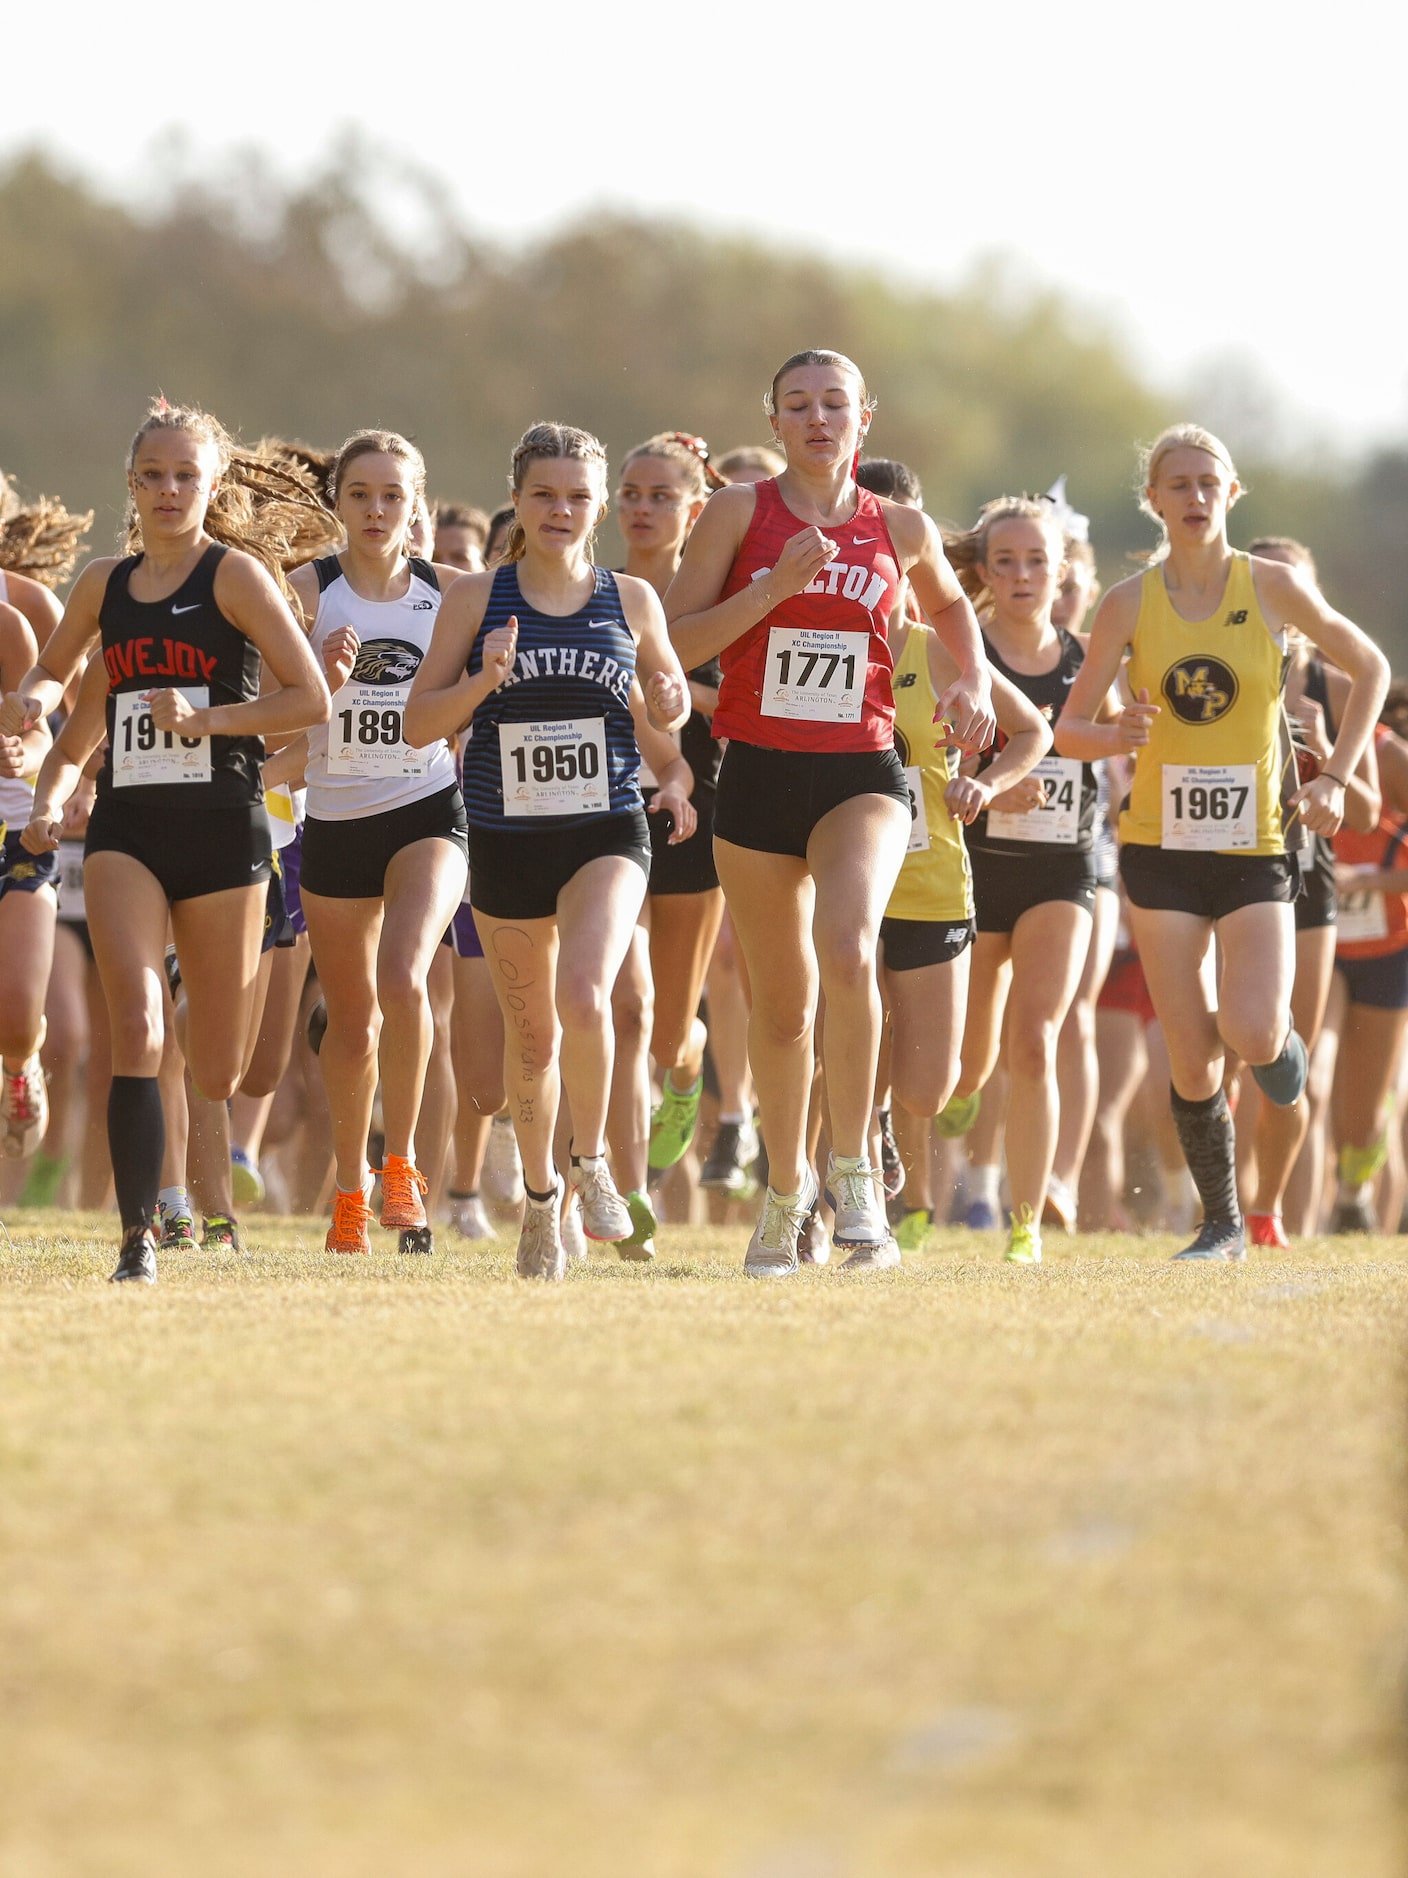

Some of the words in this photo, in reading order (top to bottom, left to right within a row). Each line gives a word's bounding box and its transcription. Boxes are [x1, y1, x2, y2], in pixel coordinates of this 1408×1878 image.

[800, 631, 810, 639] UIL
[812, 632, 834, 641] Region
[802, 640, 847, 651] Championship
[105, 637, 218, 695] OVEJOY
[495, 647, 629, 696] ANTHERS
[776, 650, 855, 690] 1771
[371, 690, 394, 698] Region
[338, 709, 410, 746] 189
[523, 734, 533, 742] XC
[534, 732, 582, 743] Championship
[530, 724, 541, 732] UIL
[543, 724, 566, 733] Region
[510, 742, 599, 783] 1950
[535, 790, 577, 798] ARLINGTON
[1039, 779, 1074, 811] 24
[1170, 786, 1249, 820] 1967
[492, 926, 536, 1082] Colossians
